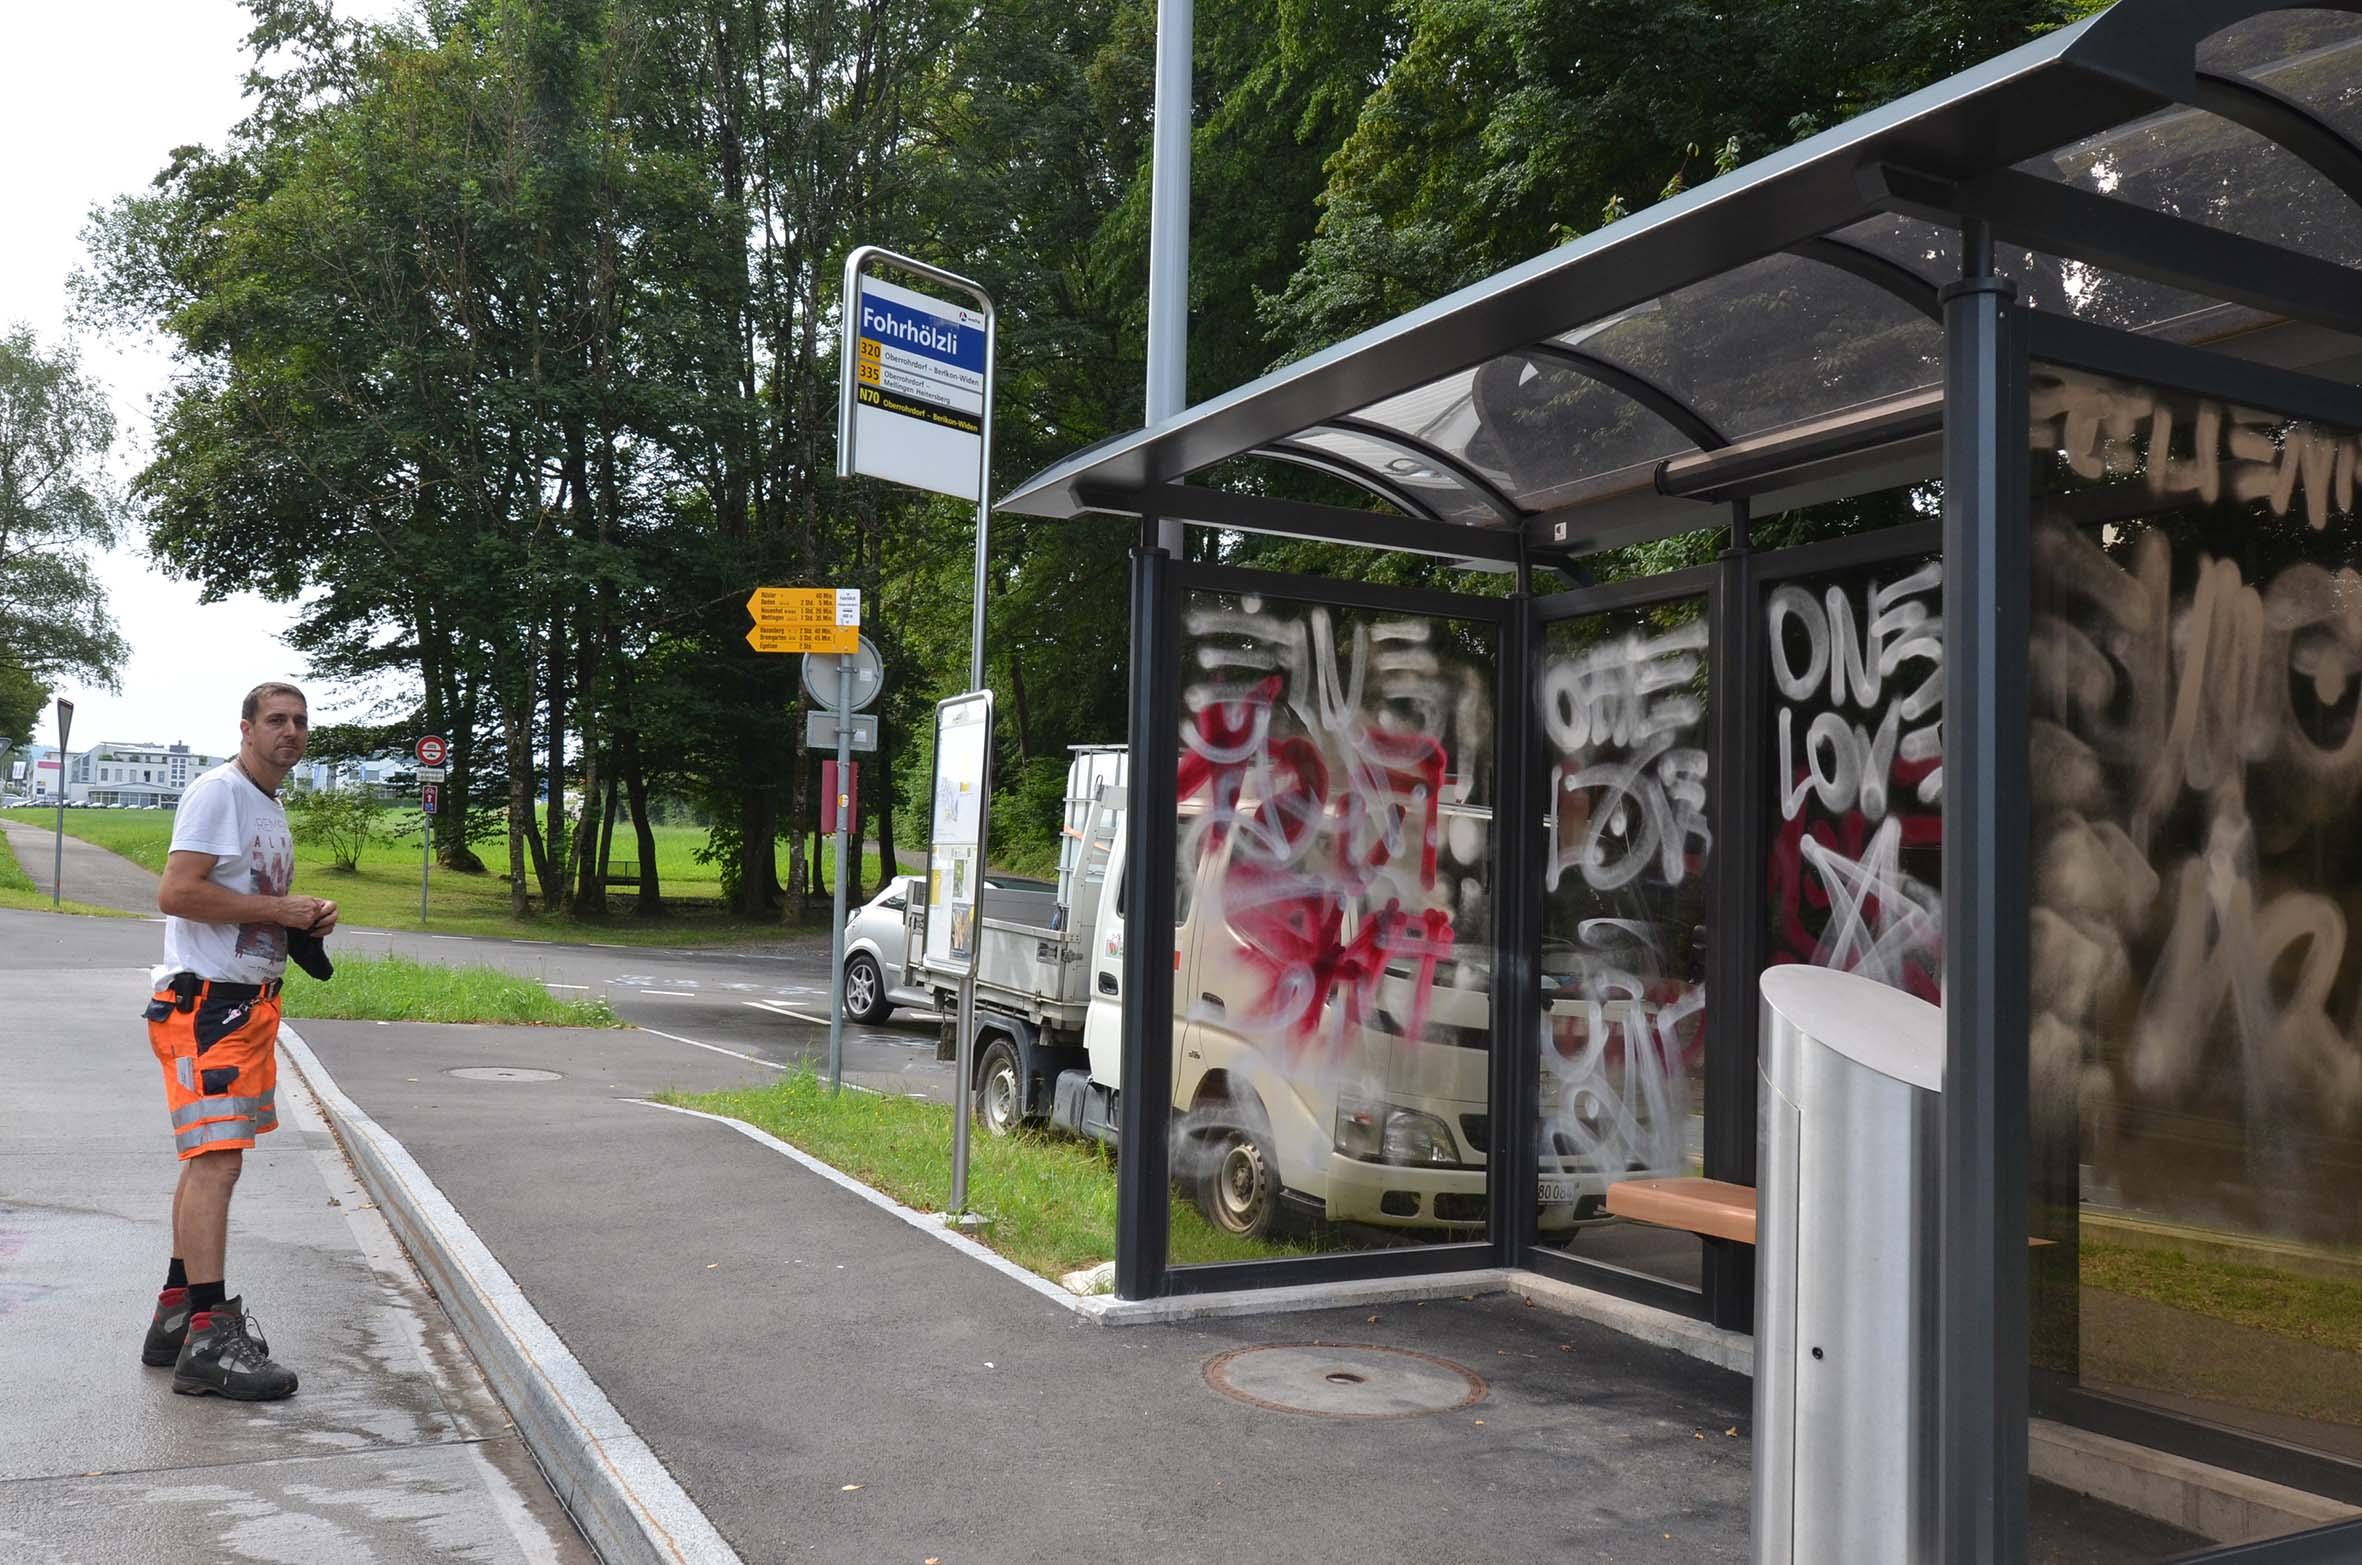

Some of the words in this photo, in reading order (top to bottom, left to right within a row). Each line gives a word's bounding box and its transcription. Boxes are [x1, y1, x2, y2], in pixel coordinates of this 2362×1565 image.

[864, 307, 958, 355] Fohrhölzli
[860, 365, 880, 381] 335
[884, 370, 925, 388] Oberrohrdorf
[861, 341, 880, 358] 320
[885, 352, 928, 370] Oberrohrdorf
[934, 366, 980, 386] Berikon-Widen
[859, 387, 880, 404] N70
[883, 399, 926, 417] Oberrohrdorf
[932, 412, 978, 432] Berikon-Widen
